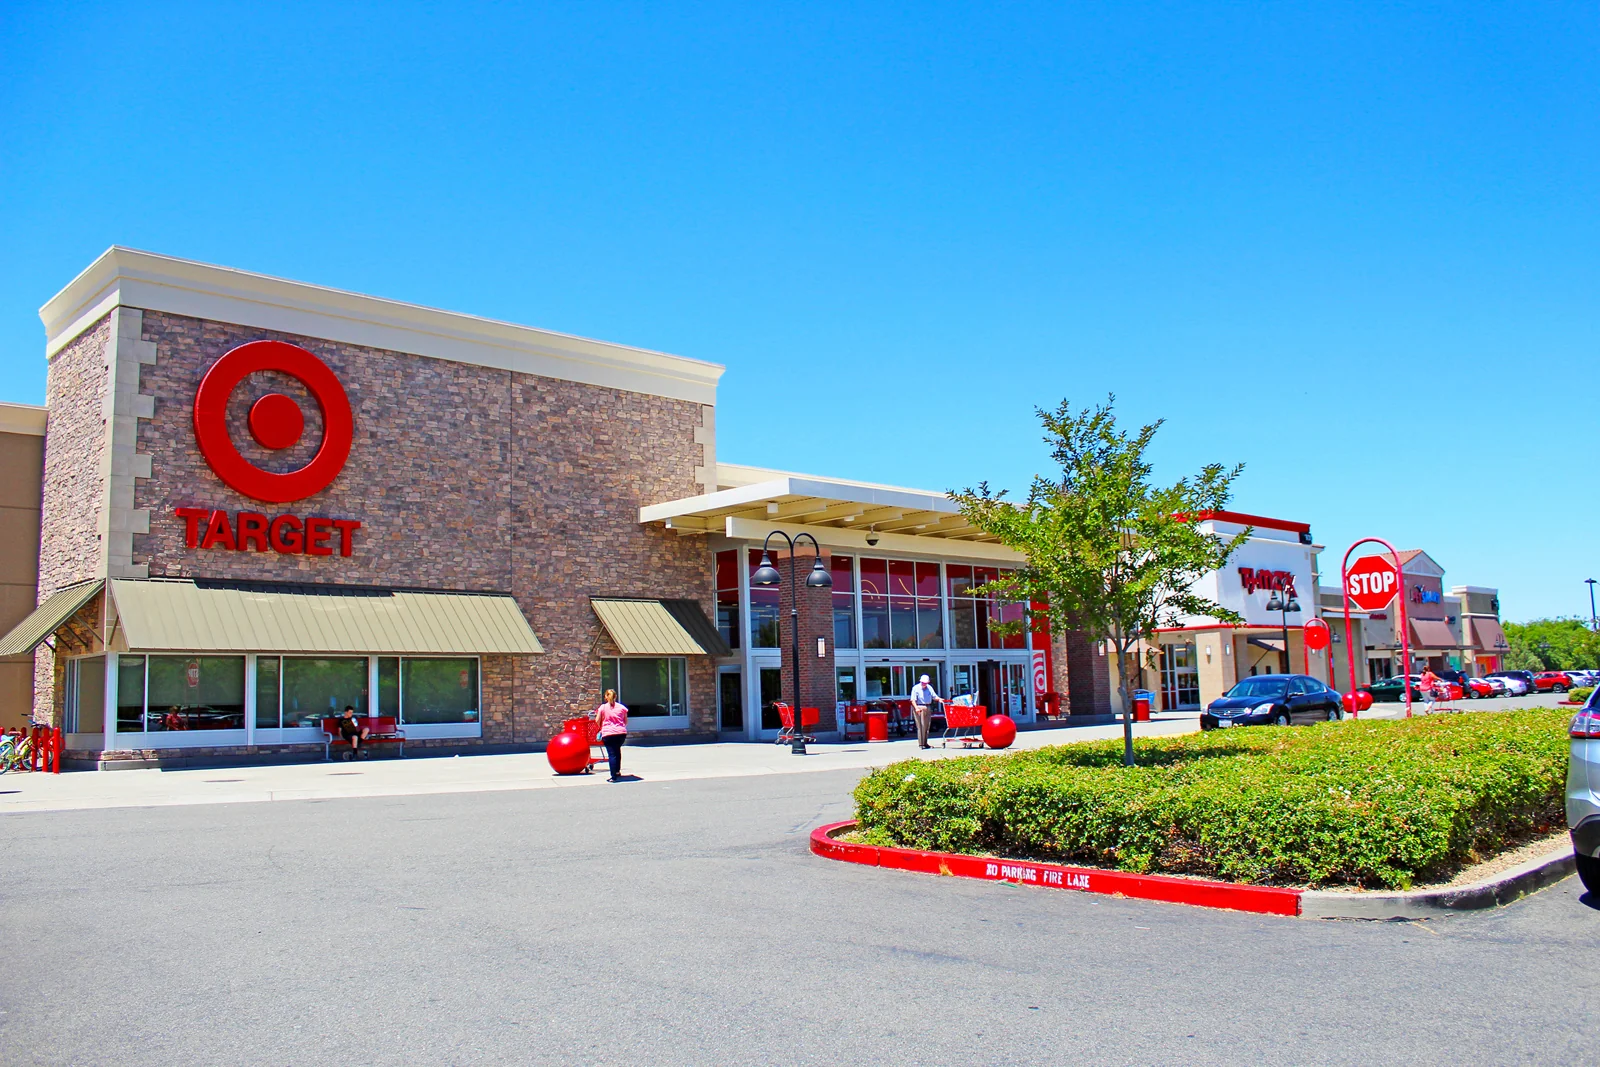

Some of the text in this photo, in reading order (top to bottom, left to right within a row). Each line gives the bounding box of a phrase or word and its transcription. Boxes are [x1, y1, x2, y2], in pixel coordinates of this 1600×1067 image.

[175, 507, 361, 557] TARGET
[1349, 571, 1395, 596] STOP
[986, 863, 1090, 888] NO PARKING FIRE LANE
